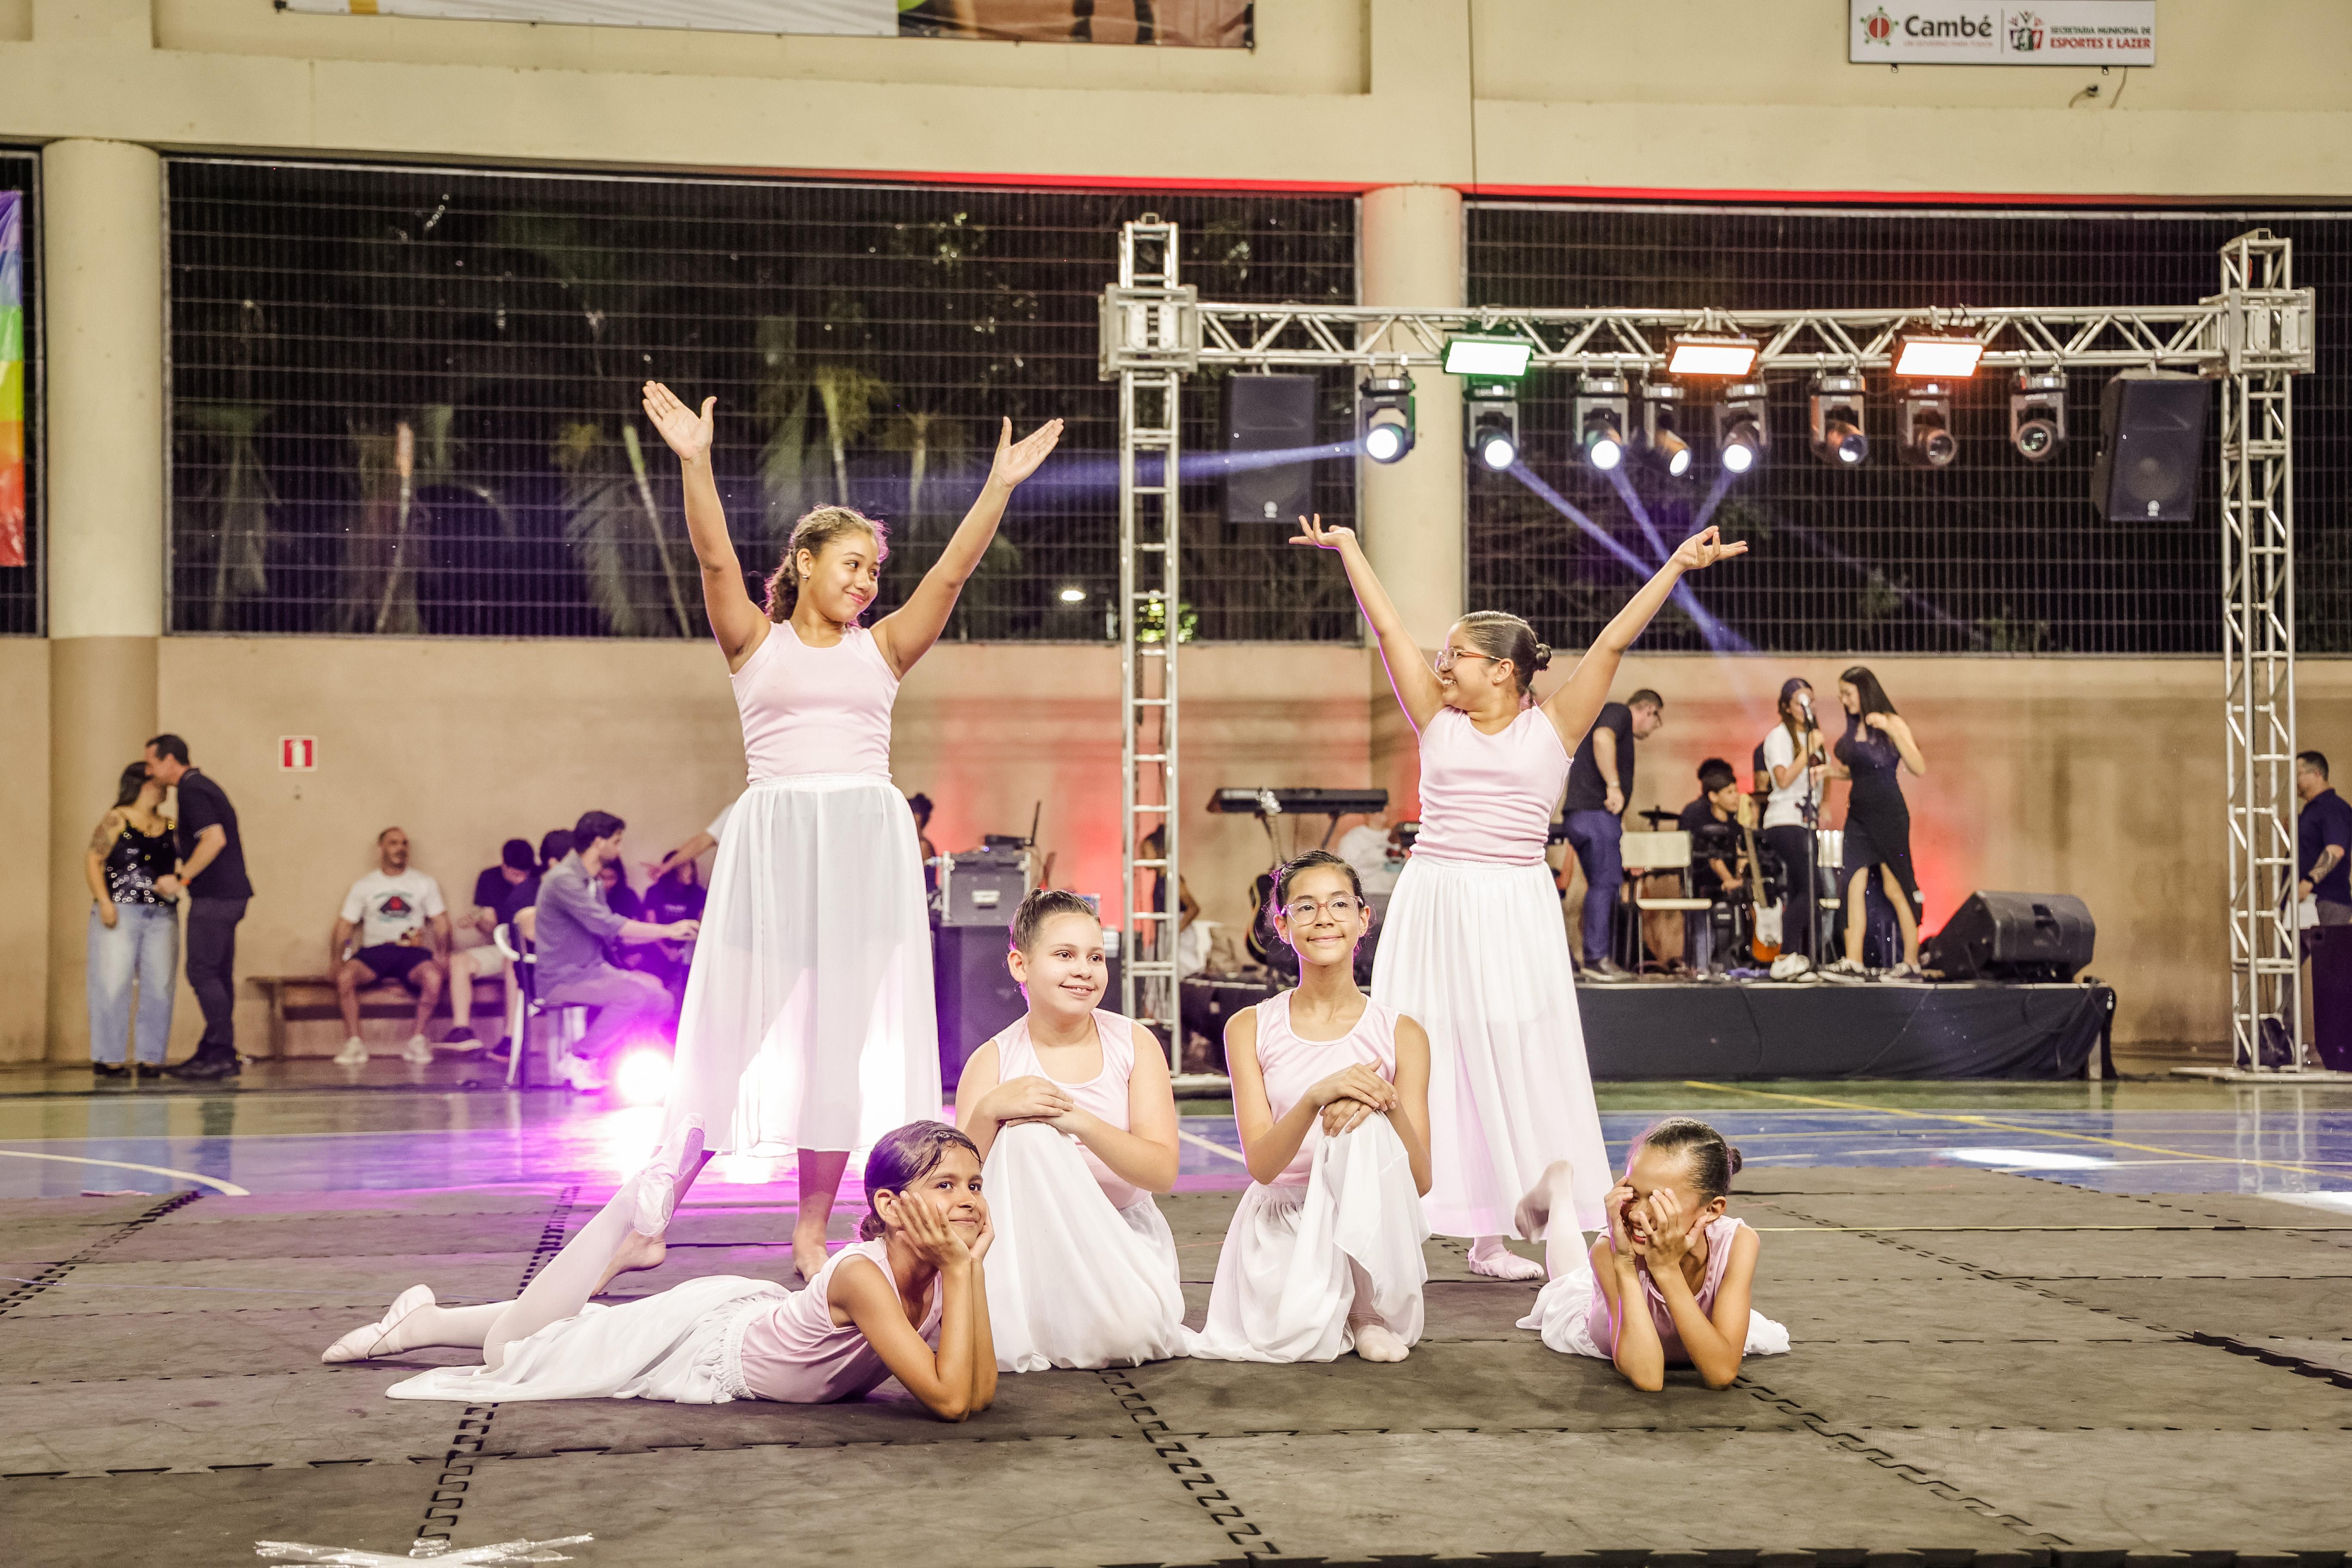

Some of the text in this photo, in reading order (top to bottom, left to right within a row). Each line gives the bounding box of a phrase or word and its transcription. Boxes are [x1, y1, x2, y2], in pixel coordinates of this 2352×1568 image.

[1905, 15, 1992, 37] Cambé
[2097, 26, 2138, 35] MUNICIPAL
[2050, 37, 2151, 49] ESPORTES E LAZER
